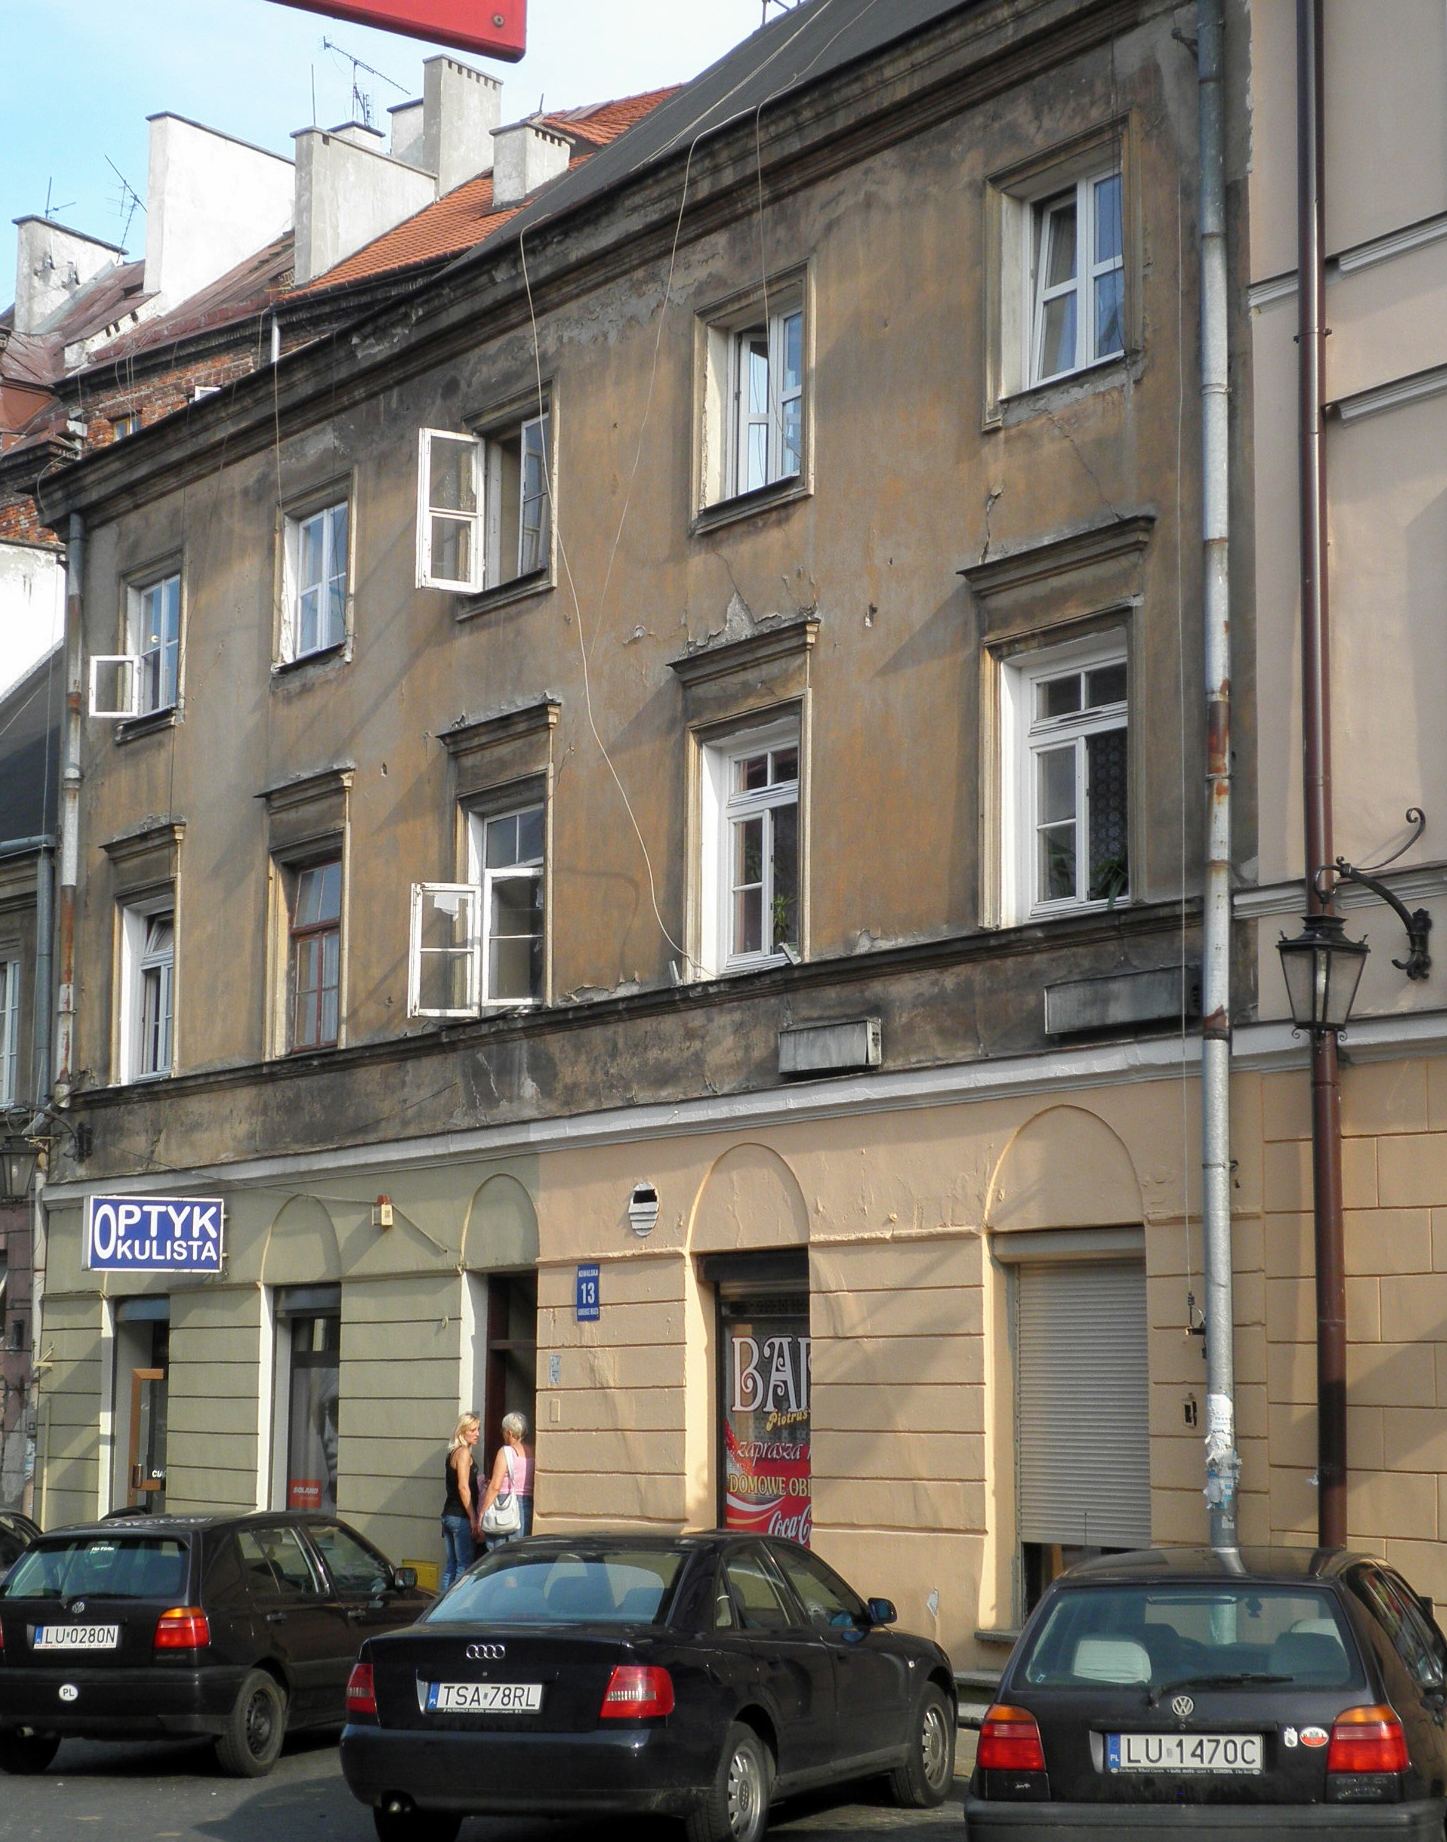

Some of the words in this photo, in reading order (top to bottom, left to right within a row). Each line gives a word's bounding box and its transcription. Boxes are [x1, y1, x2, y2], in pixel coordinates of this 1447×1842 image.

[94, 1204, 217, 1259] OPTYK
[581, 1282, 595, 1304] 13
[737, 1442, 803, 1467] zaprasza
[729, 1475, 786, 1496] DOMOWE
[45, 1628, 65, 1644] LU
[70, 1628, 116, 1644] 0280N
[63, 1688, 74, 1696] PL
[444, 1686, 481, 1706] TSA
[489, 1686, 535, 1707] 78RL
[1127, 1738, 1162, 1764] LU
[1175, 1738, 1256, 1764] 1470C
